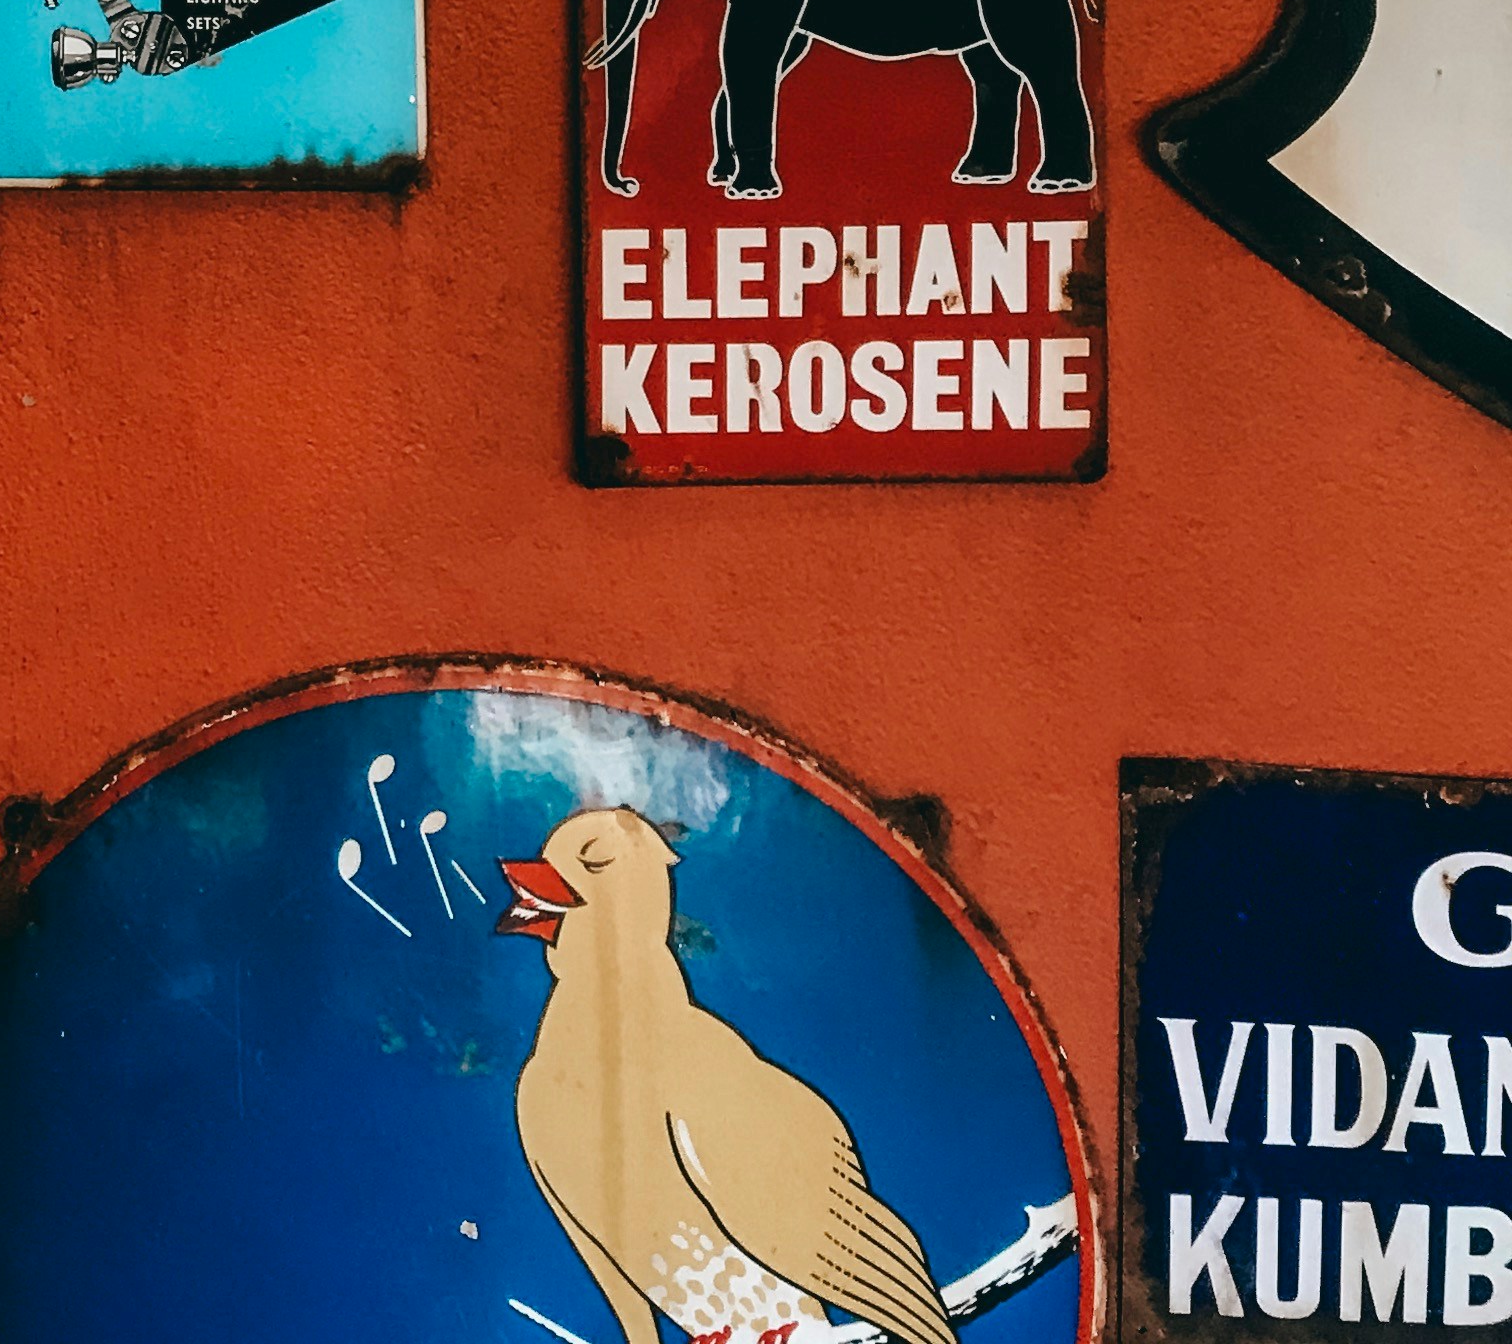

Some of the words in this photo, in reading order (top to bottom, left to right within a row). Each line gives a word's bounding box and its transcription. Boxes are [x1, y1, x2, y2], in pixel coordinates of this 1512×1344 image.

[186, 16, 221, 30] SETS
[600, 218, 1092, 322] ELEPHANT
[598, 336, 1092, 436] KEROSENE
